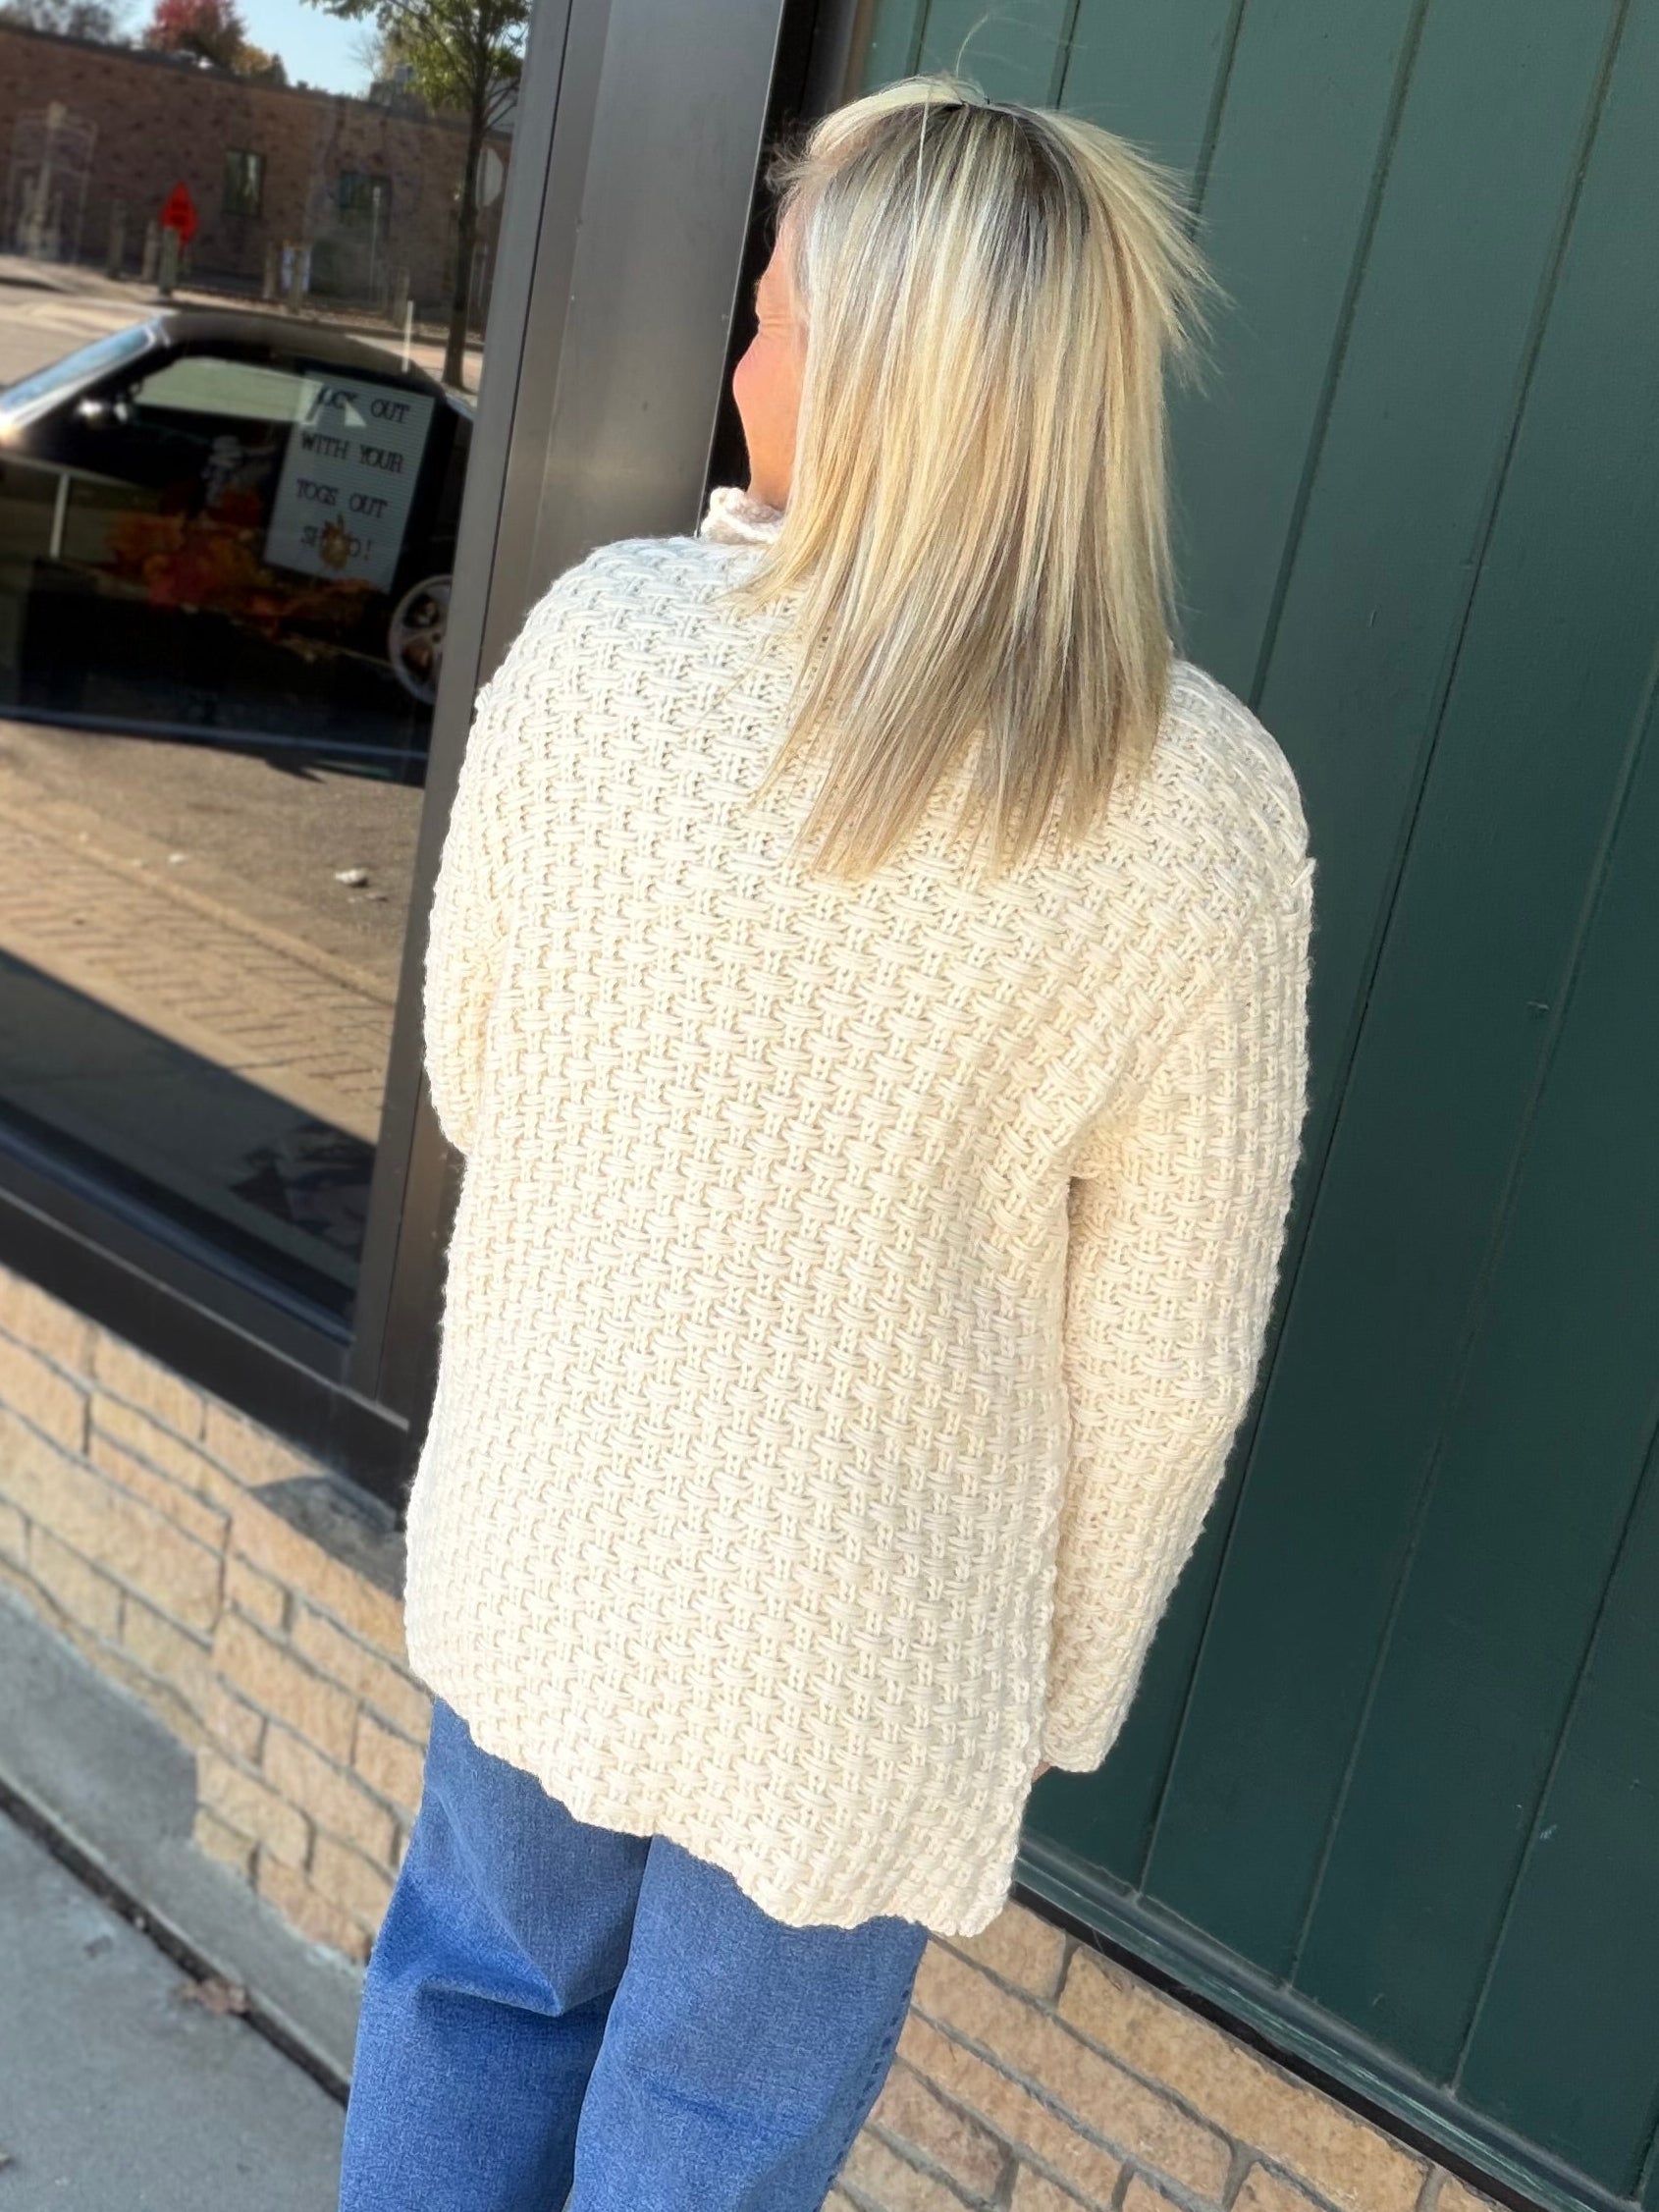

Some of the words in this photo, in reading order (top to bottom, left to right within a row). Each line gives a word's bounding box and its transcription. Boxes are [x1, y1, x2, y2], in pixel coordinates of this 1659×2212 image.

[370, 398, 410, 423] OUT
[300, 430, 349, 460] WITH
[359, 443, 403, 474] YOUR
[348, 492, 388, 518] OUT
